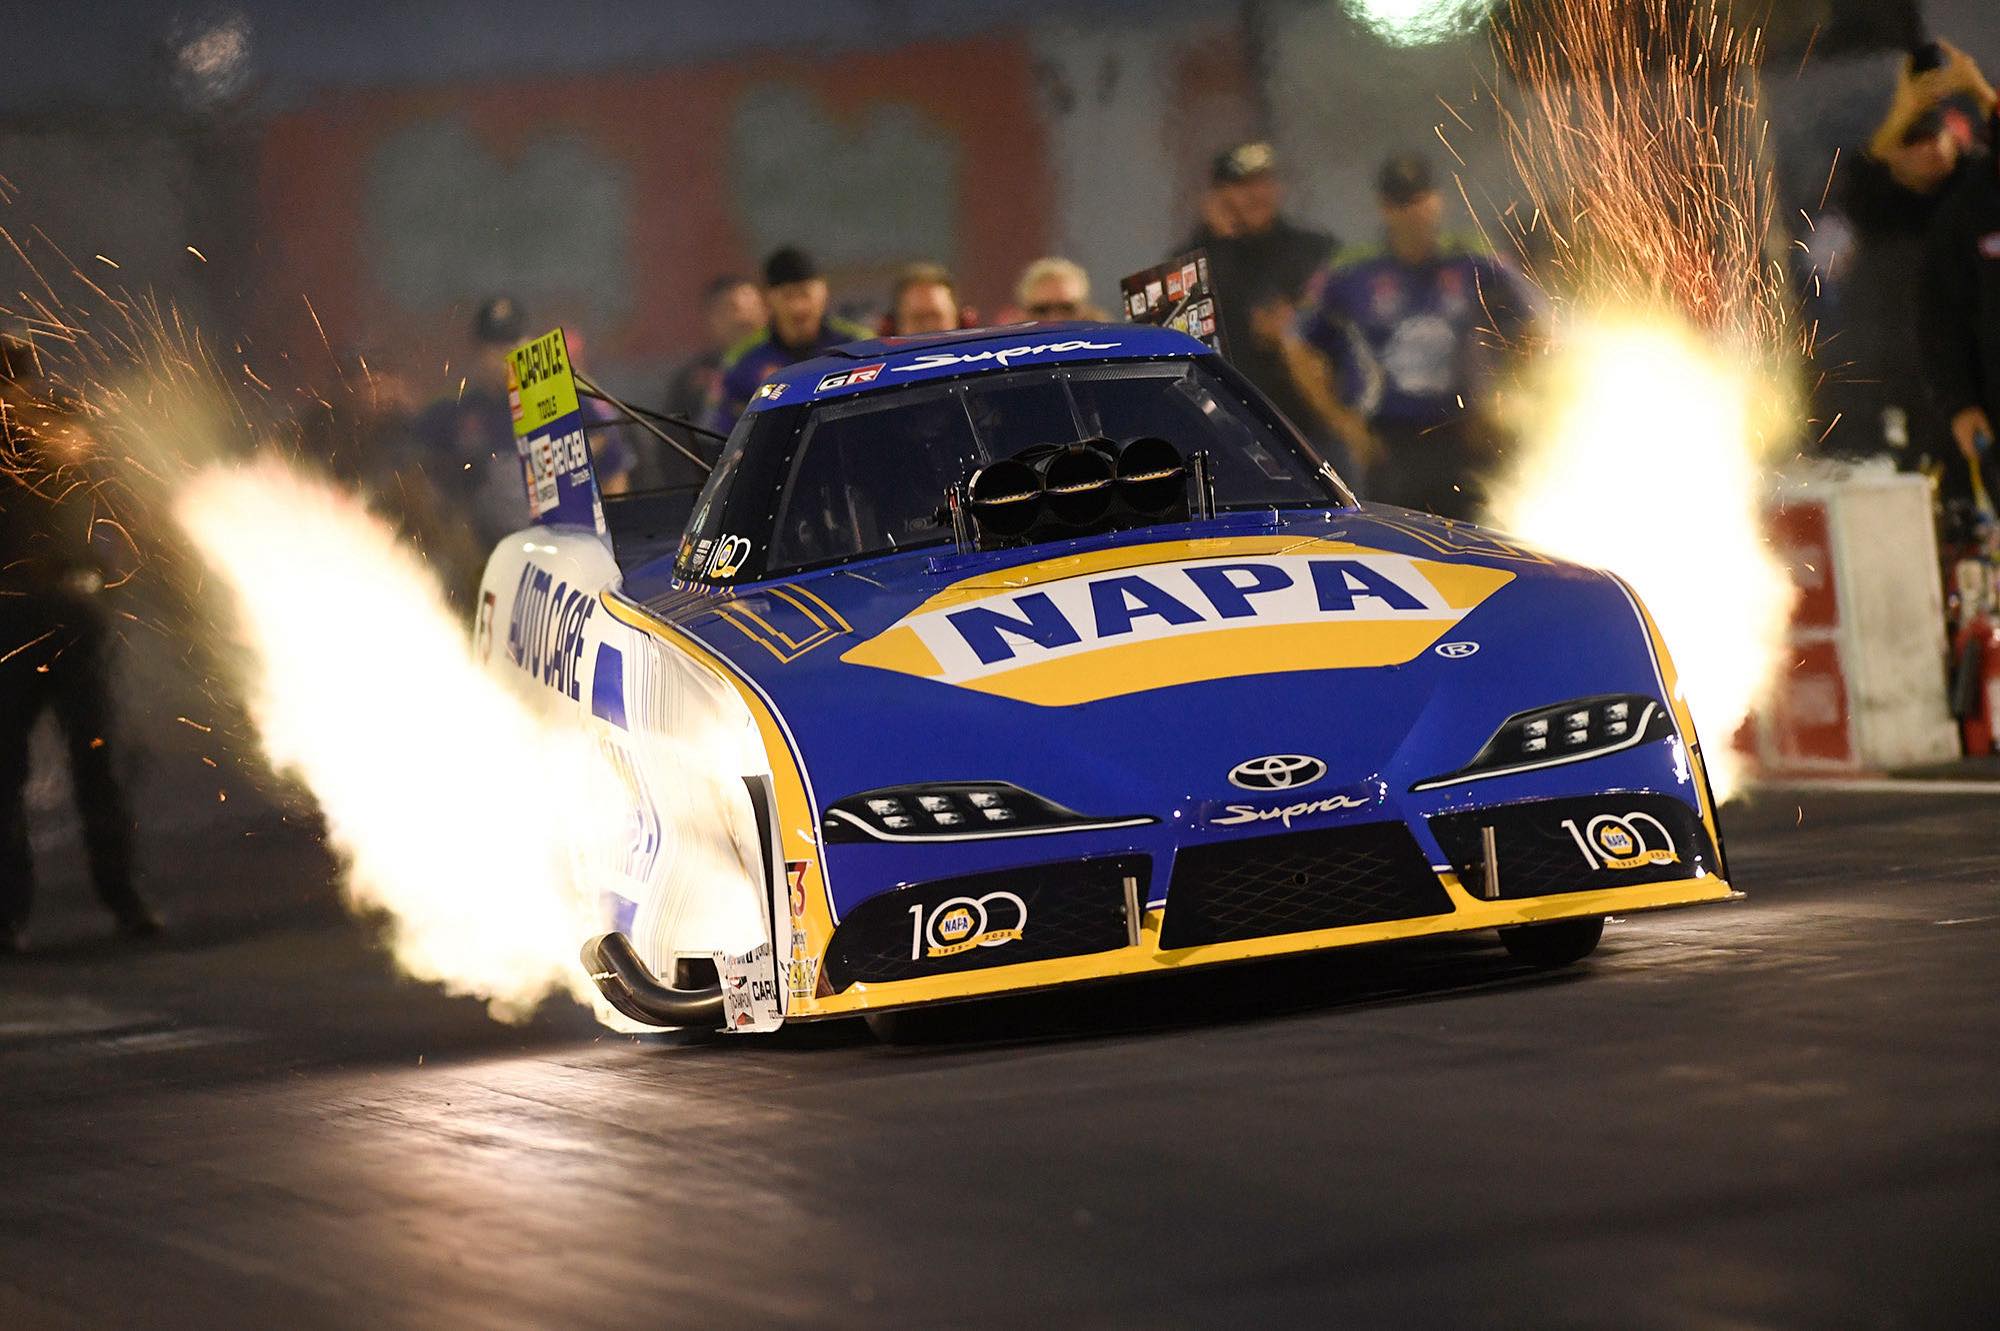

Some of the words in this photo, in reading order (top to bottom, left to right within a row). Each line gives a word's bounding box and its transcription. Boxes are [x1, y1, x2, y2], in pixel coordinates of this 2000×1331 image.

[819, 370, 878, 390] GR
[891, 341, 1121, 371] Supra
[544, 581, 596, 702] CARE
[946, 559, 1428, 665] NAPA
[1210, 795, 1370, 828] Supra
[908, 891, 1028, 960] 100
[945, 917, 969, 933] NAPA
